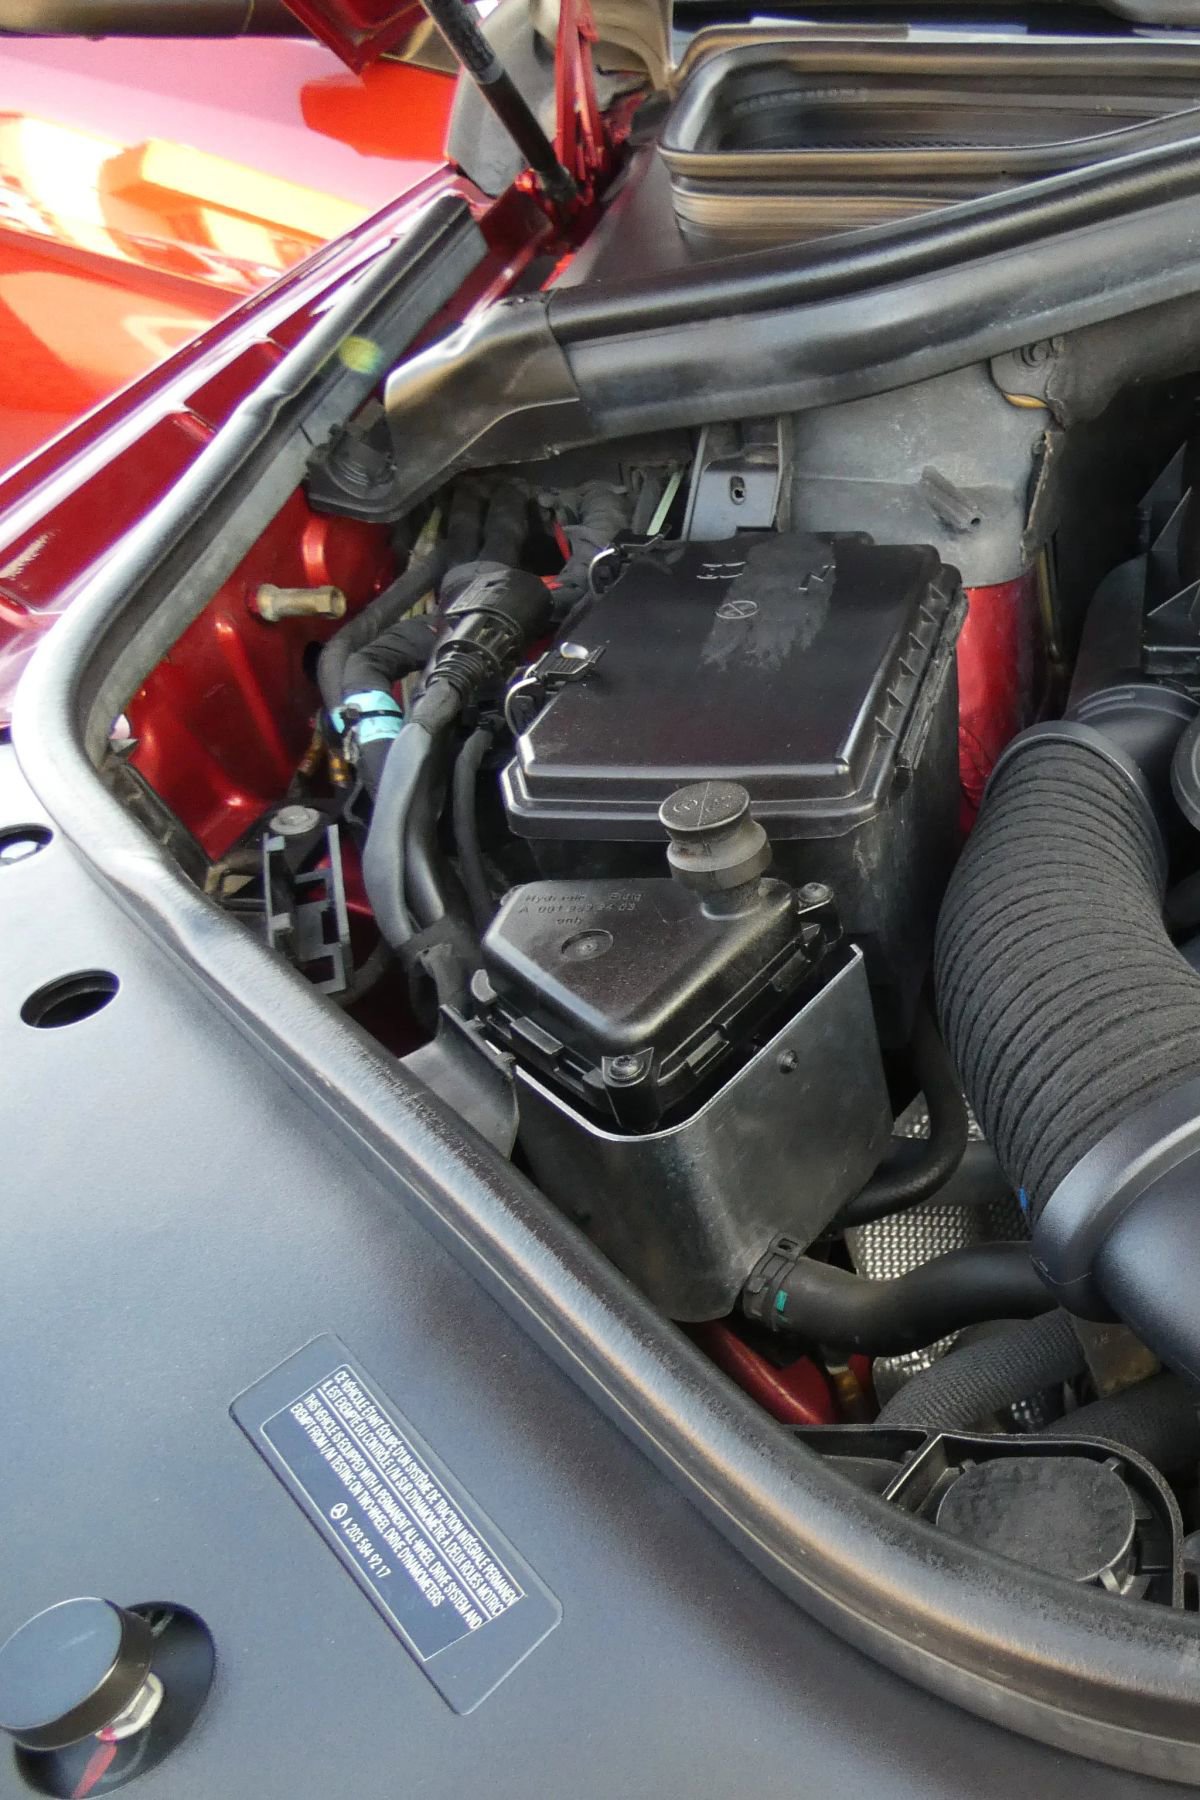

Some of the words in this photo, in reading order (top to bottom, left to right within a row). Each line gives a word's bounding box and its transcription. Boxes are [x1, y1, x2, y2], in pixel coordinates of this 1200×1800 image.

[321, 1379, 334, 1390] IL
[333, 1369, 349, 1383] CE
[303, 1392, 322, 1411] THIS
[325, 1384, 343, 1401] EST
[340, 1377, 370, 1411] VÉHICULE
[290, 1401, 316, 1430] EXEMPT
[313, 1405, 340, 1436] VEHICLE
[333, 1395, 364, 1427] EXEMPTÉ
[360, 1405, 384, 1429] ÉTANT
[306, 1424, 329, 1448] FROM
[331, 1430, 345, 1443] IS
[353, 1421, 370, 1437] DU
[375, 1423, 402, 1451] ÉQUIPÉ
[320, 1442, 338, 1460] I/M
[336, 1436, 367, 1472] EQUIPPED
[361, 1431, 394, 1469] CONTRÔLE
[391, 1445, 413, 1467] D'UN
[328, 1454, 357, 1485] TESTING
[357, 1466, 380, 1489] WITH
[385, 1463, 404, 1481] I/M
[347, 1479, 365, 1496] ON
[370, 1483, 384, 1495] A
[394, 1475, 414, 1494] SUR
[424, 1488, 441, 1504] DE
[340, 1515, 354, 1528] A
[354, 1490, 392, 1533] TWO-WHEEL
[373, 1488, 412, 1531] PERMANENT
[404, 1488, 449, 1541] DYNAMOMÈTRE
[432, 1498, 465, 1535] TRACTION
[344, 1522, 365, 1542] 203
[381, 1526, 407, 1553] DRIVE
[439, 1536, 455, 1548] À
[355, 1537, 376, 1558] 584
[402, 1526, 438, 1567] ALL-WHEEL
[444, 1542, 468, 1566] DEUX
[454, 1528, 491, 1569] INTÉGRALE
[366, 1552, 384, 1569] 92
[374, 1564, 391, 1579] 17
[395, 1546, 446, 1607] DYNAMOMETERS
[427, 1560, 453, 1588] DRIVE
[457, 1559, 485, 1589] ROUES
[441, 1581, 473, 1615] SYSTEM
[461, 1608, 483, 1629] AND
